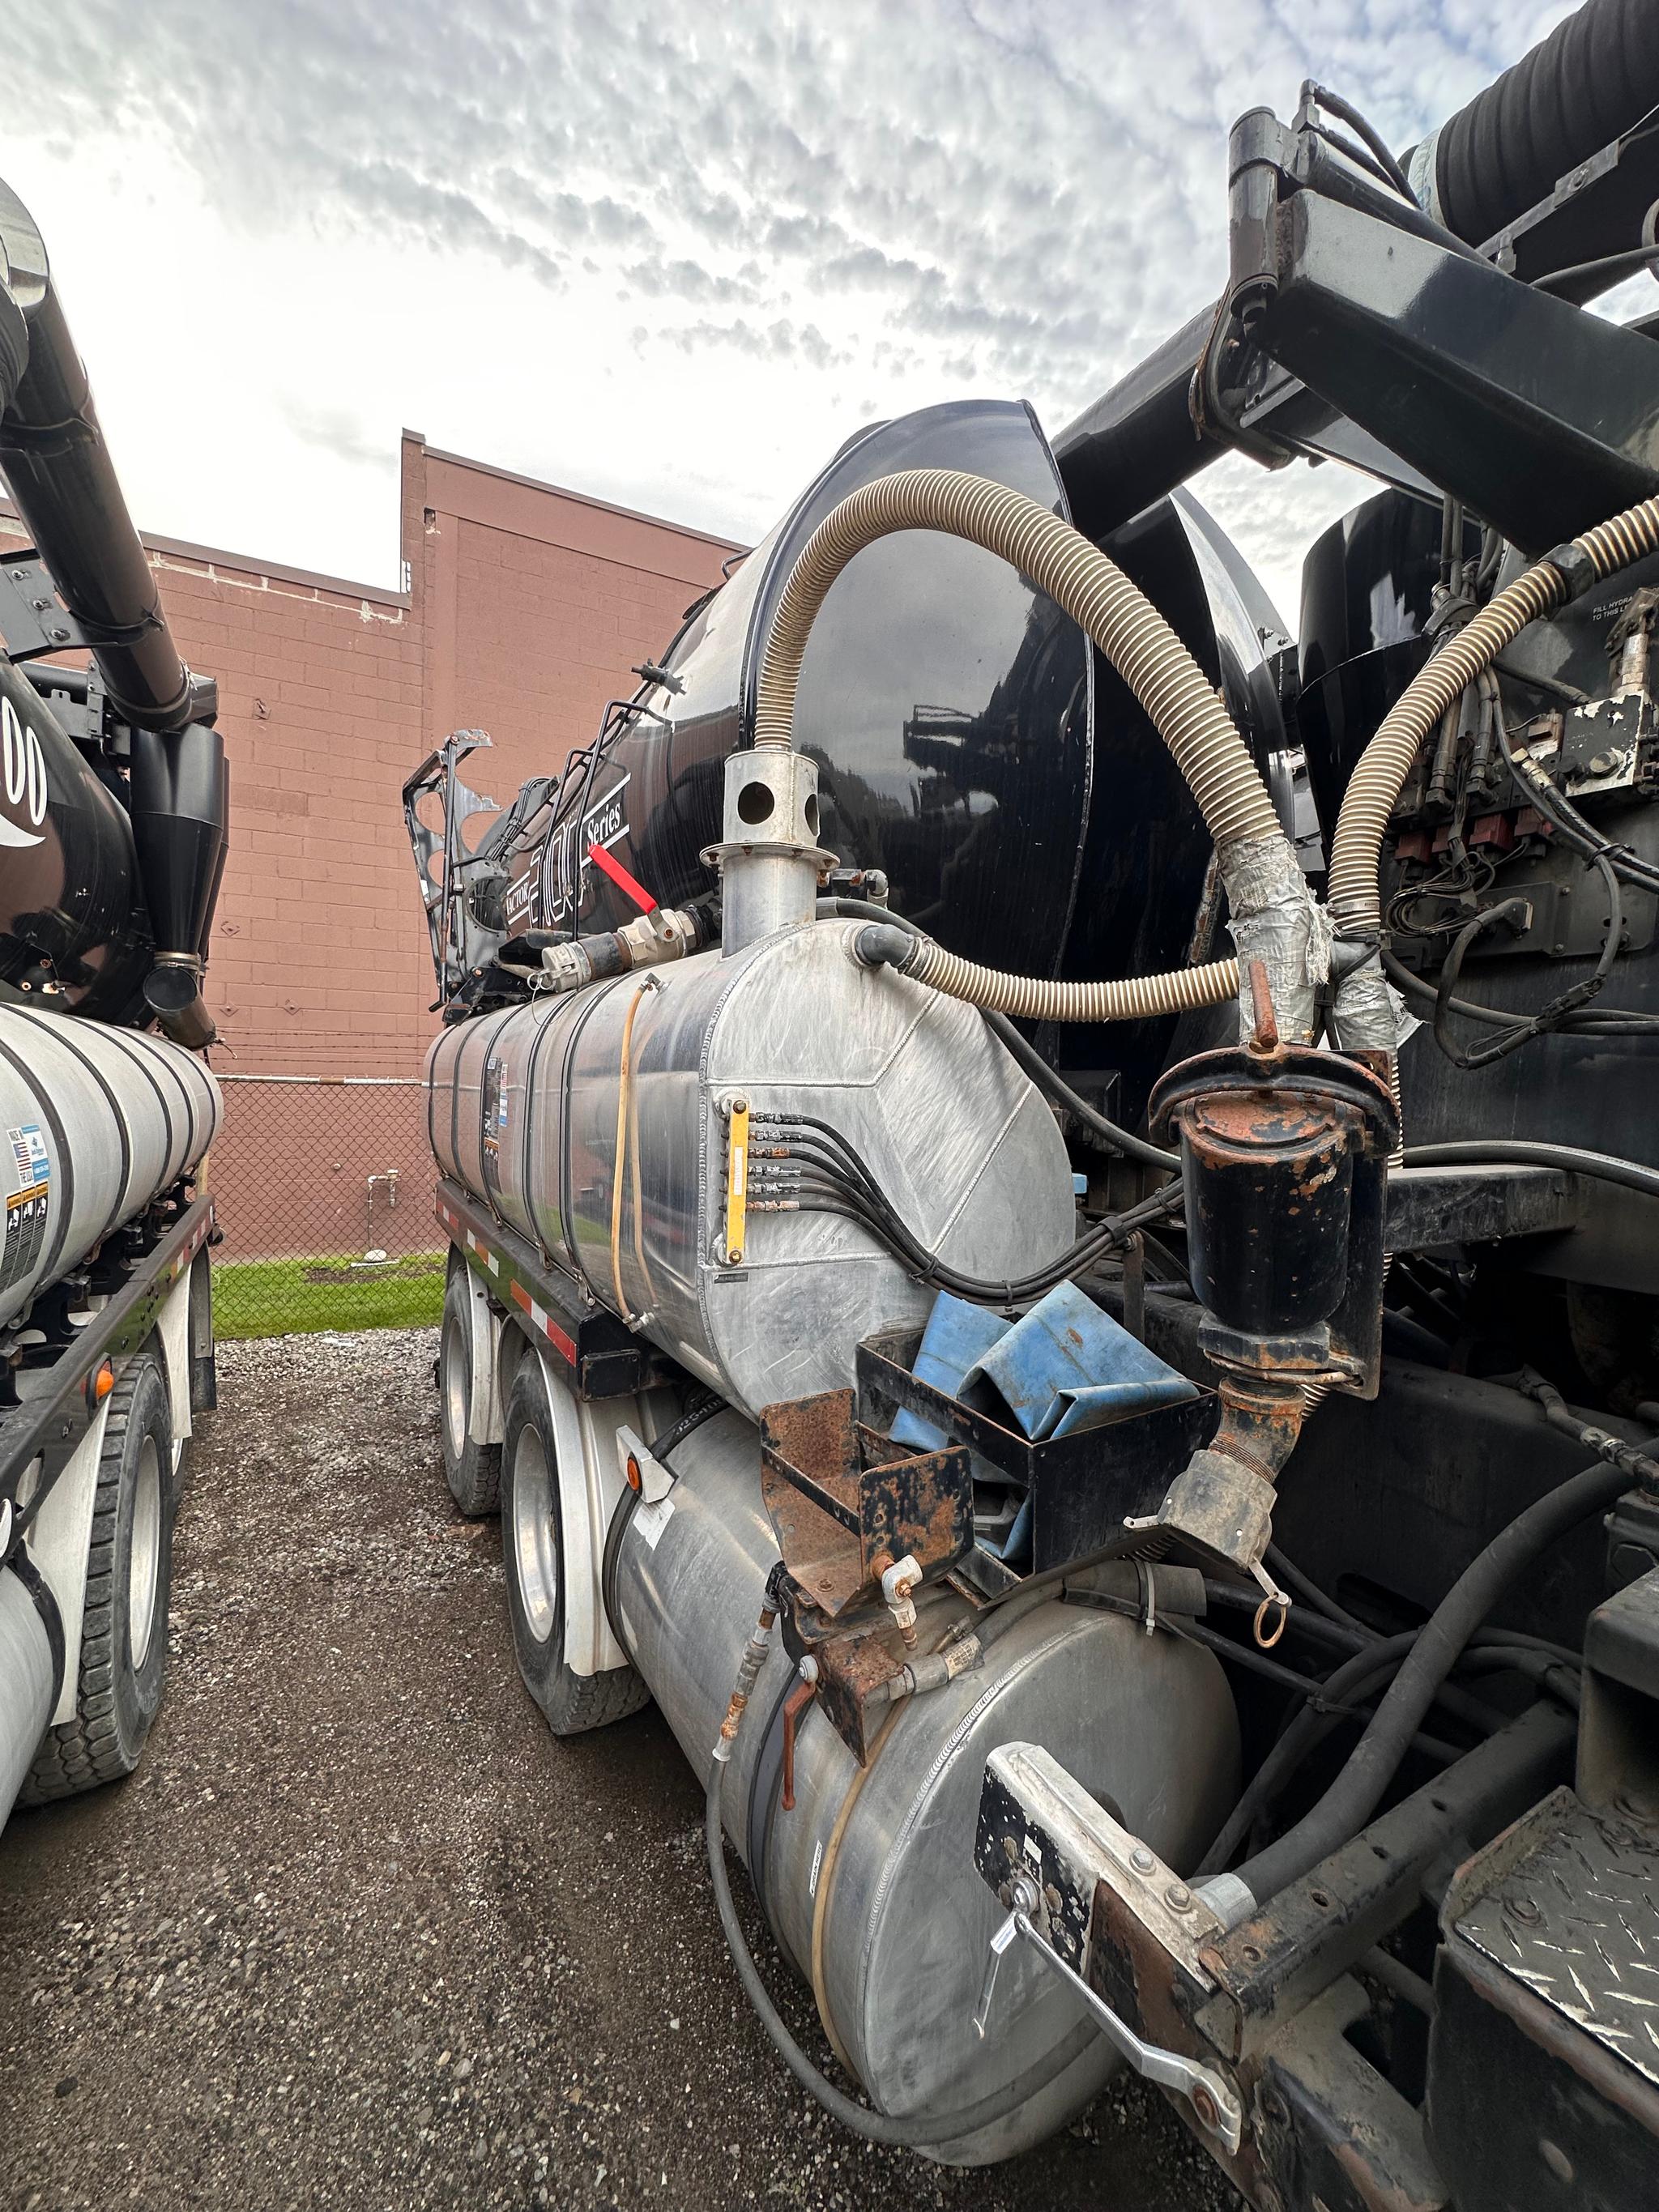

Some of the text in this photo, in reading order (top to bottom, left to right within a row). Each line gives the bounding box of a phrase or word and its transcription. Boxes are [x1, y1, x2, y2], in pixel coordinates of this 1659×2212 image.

[1592, 613, 1601, 621] TO
[1603, 607, 1618, 618] THIS
[1593, 605, 1607, 614] FILL
[587, 803, 621, 850] Series
